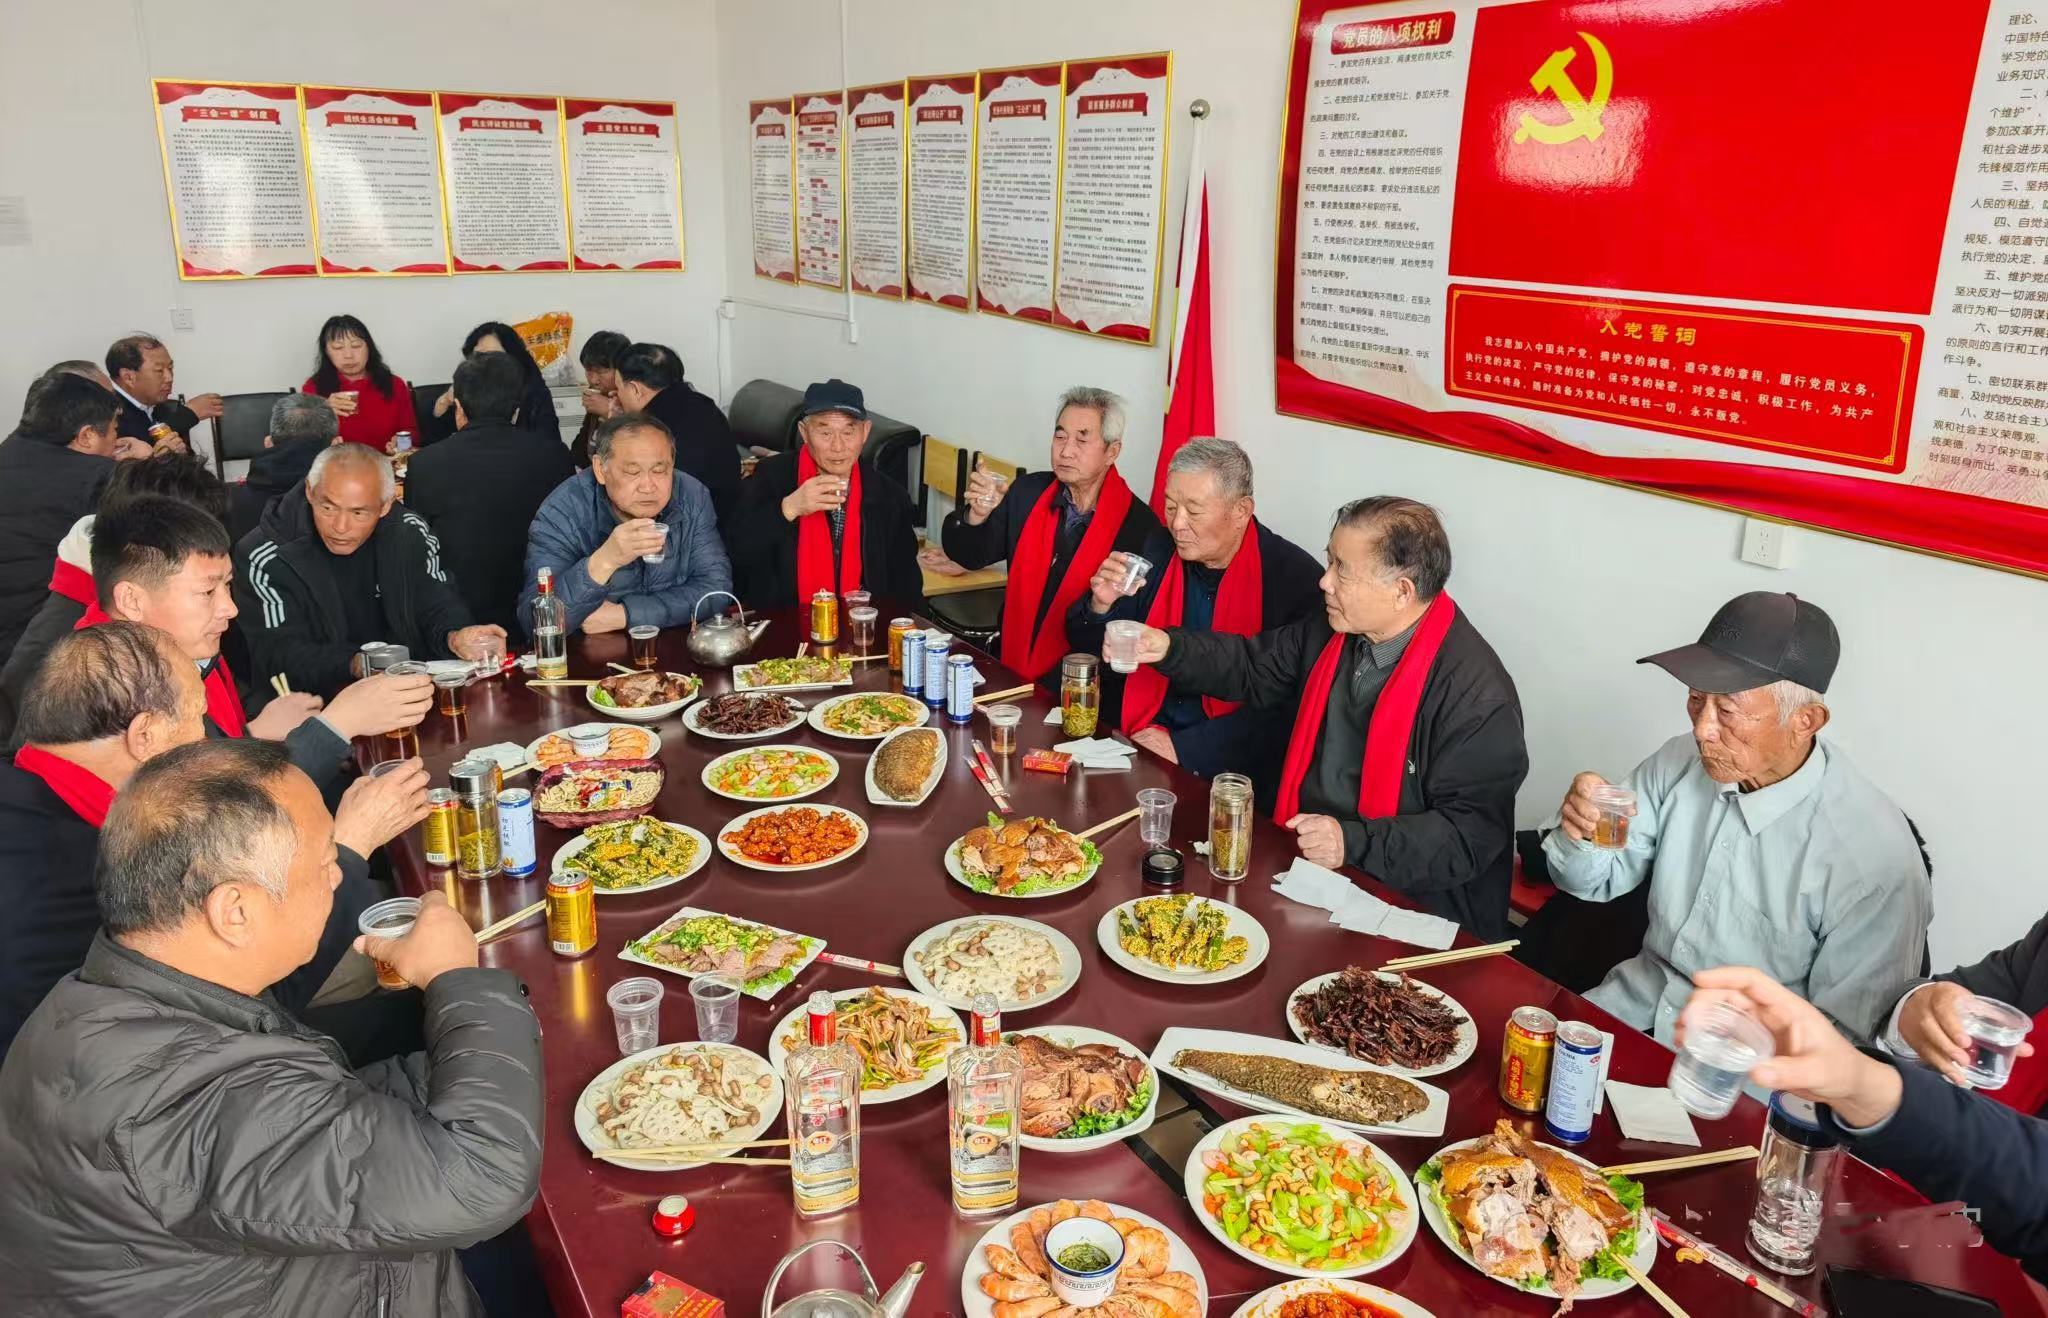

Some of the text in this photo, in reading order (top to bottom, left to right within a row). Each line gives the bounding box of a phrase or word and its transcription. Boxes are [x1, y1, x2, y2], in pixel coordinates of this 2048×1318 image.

[1342, 17, 1442, 49] 党员的八项权利
[2020, 87, 2048, 98] 二、
[1986, 123, 2048, 137] 参加改革开
[1964, 233, 2048, 247] 规矩，模范遵守
[1955, 285, 2048, 302] 坚决反对一切派别
[1952, 303, 2048, 320] 派行为和一切阴谋
[1600, 319, 1697, 346] 入党誓词
[1974, 322, 2048, 339] 六、切实开展
[1943, 353, 1983, 369] 作斗争。
[1937, 386, 2048, 410] 商量，及时向党反映群
[1931, 435, 2048, 463] 统美德，为了保护国家
